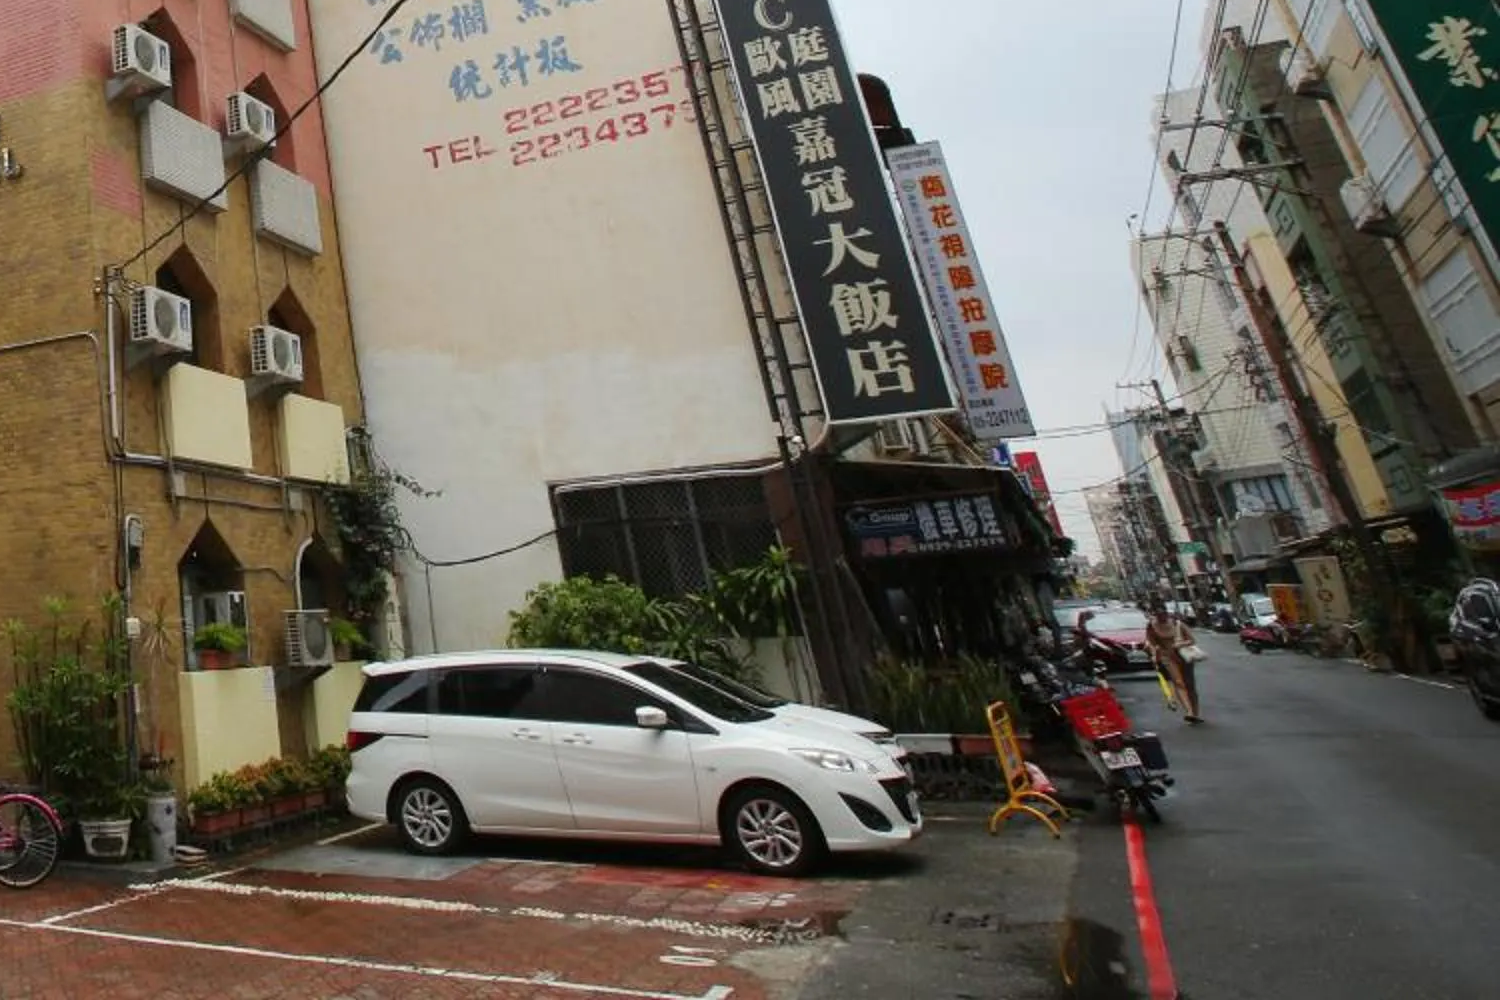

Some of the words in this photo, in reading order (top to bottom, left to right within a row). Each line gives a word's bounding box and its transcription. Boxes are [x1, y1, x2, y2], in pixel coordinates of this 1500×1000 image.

[423, 135, 498, 169] TEL
[786, 114, 917, 399] 嘉冠大飯店
